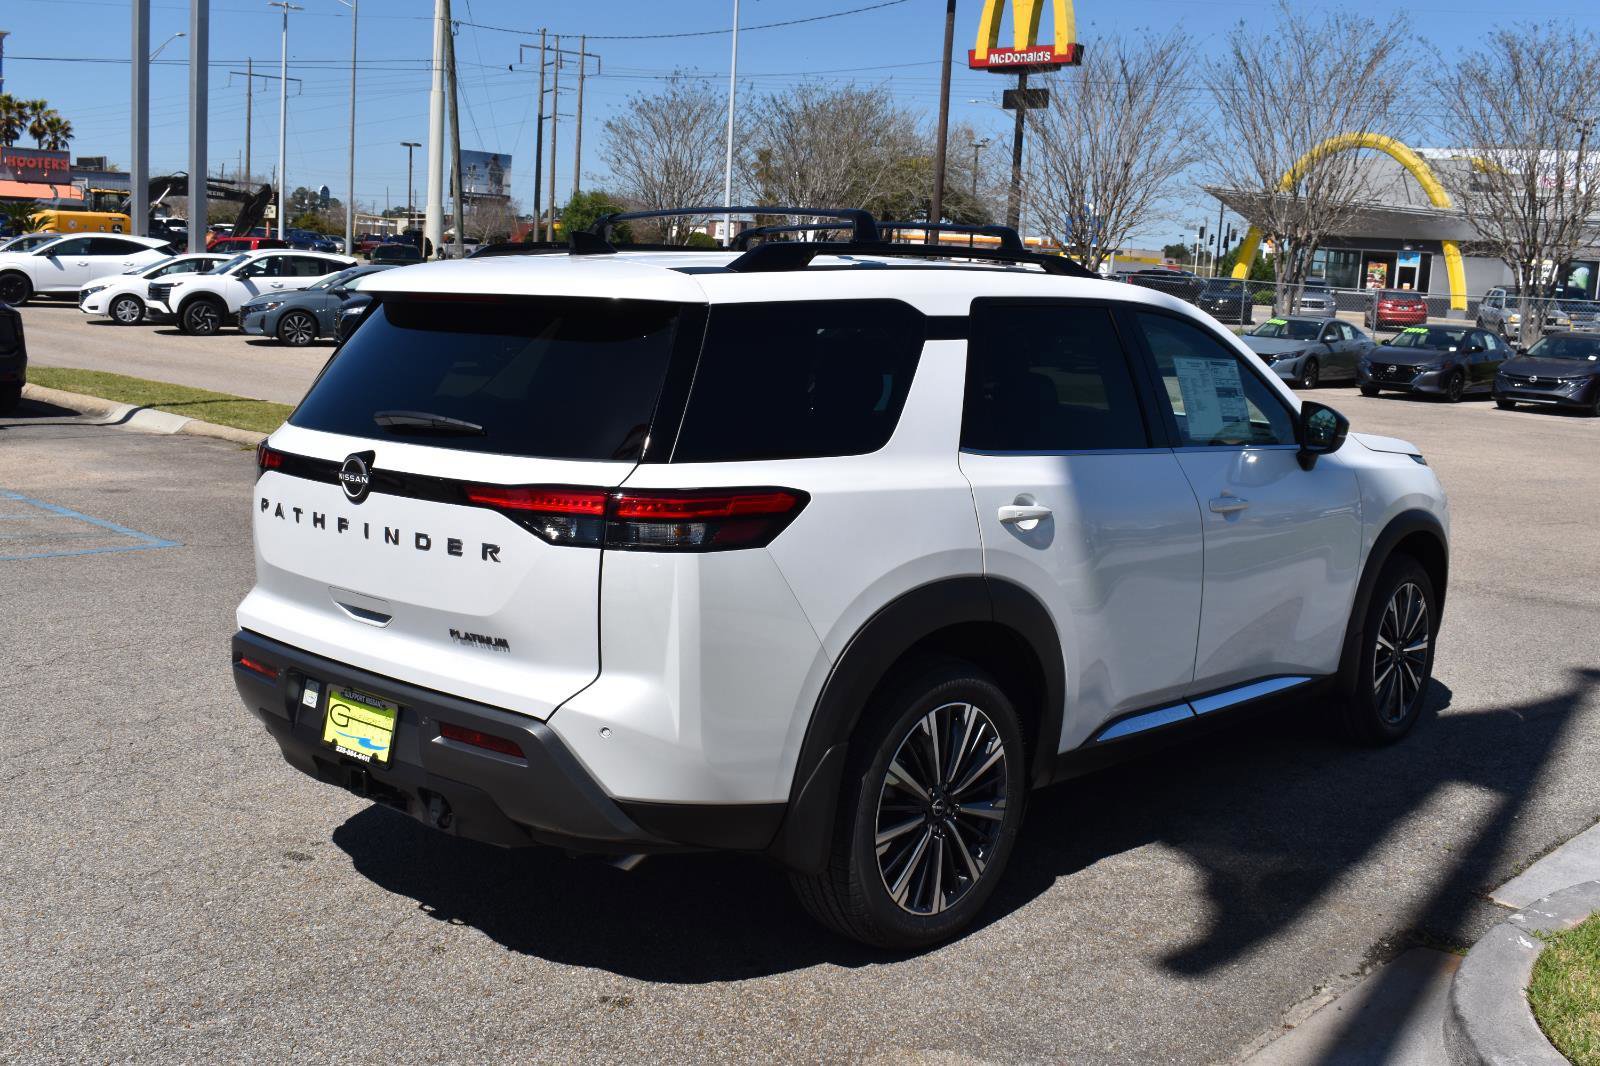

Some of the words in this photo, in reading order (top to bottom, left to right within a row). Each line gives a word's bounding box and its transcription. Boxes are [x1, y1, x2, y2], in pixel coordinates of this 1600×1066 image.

[989, 51, 1051, 64] McDonald's
[6, 155, 68, 170] HOOTERS
[338, 472, 369, 484] NISSAN
[260, 497, 502, 563] PATHFINDER
[449, 628, 509, 649] PLATINUM
